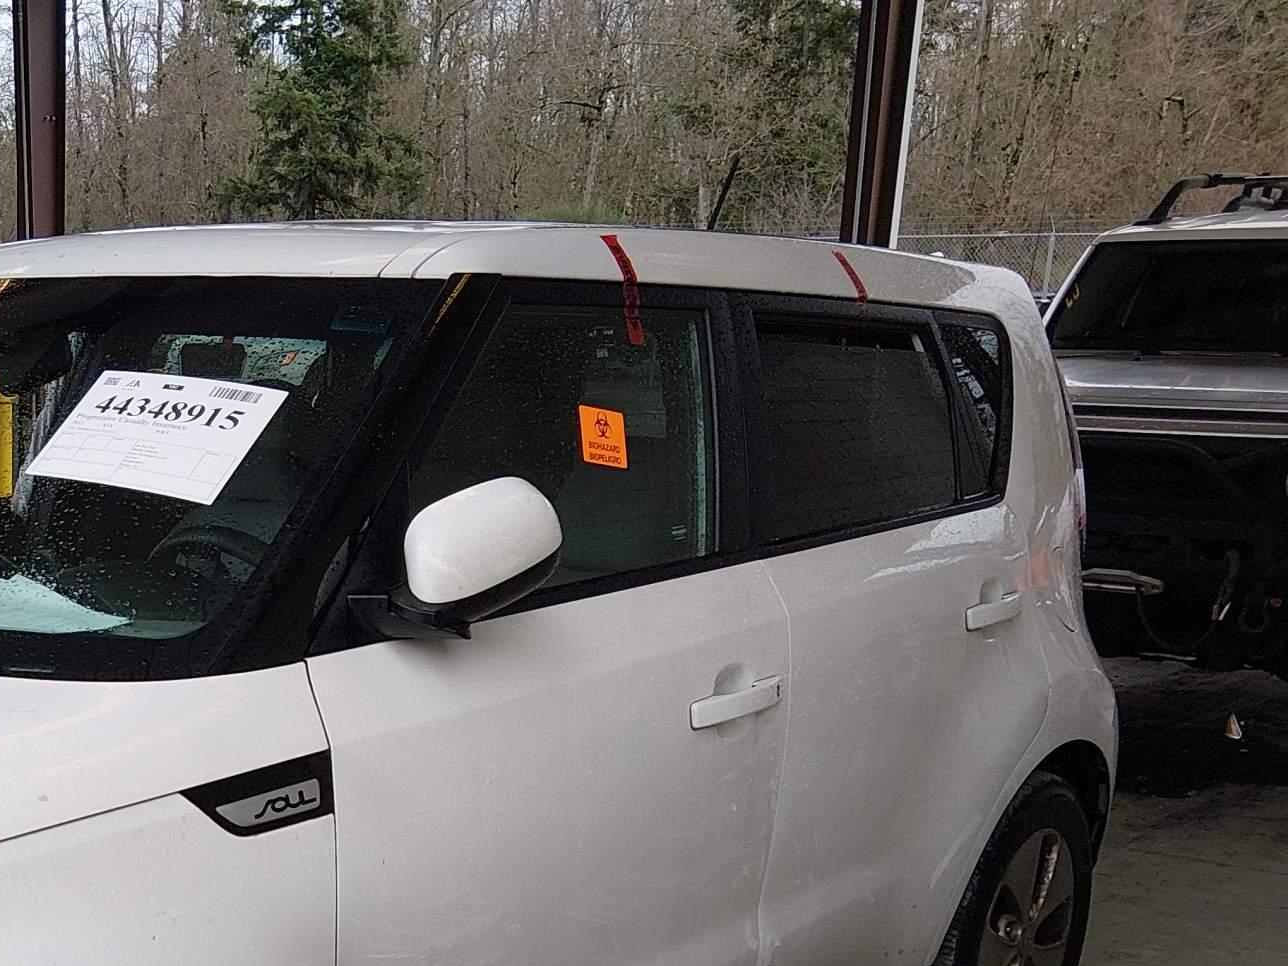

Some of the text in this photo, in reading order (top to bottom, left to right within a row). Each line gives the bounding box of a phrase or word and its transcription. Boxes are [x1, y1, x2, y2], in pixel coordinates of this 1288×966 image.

[95, 394, 247, 430] 44348915
[589, 441, 621, 453] BIOHAZARD
[589, 452, 621, 464] BIOPELIGRO
[254, 790, 317, 819] SOUL
